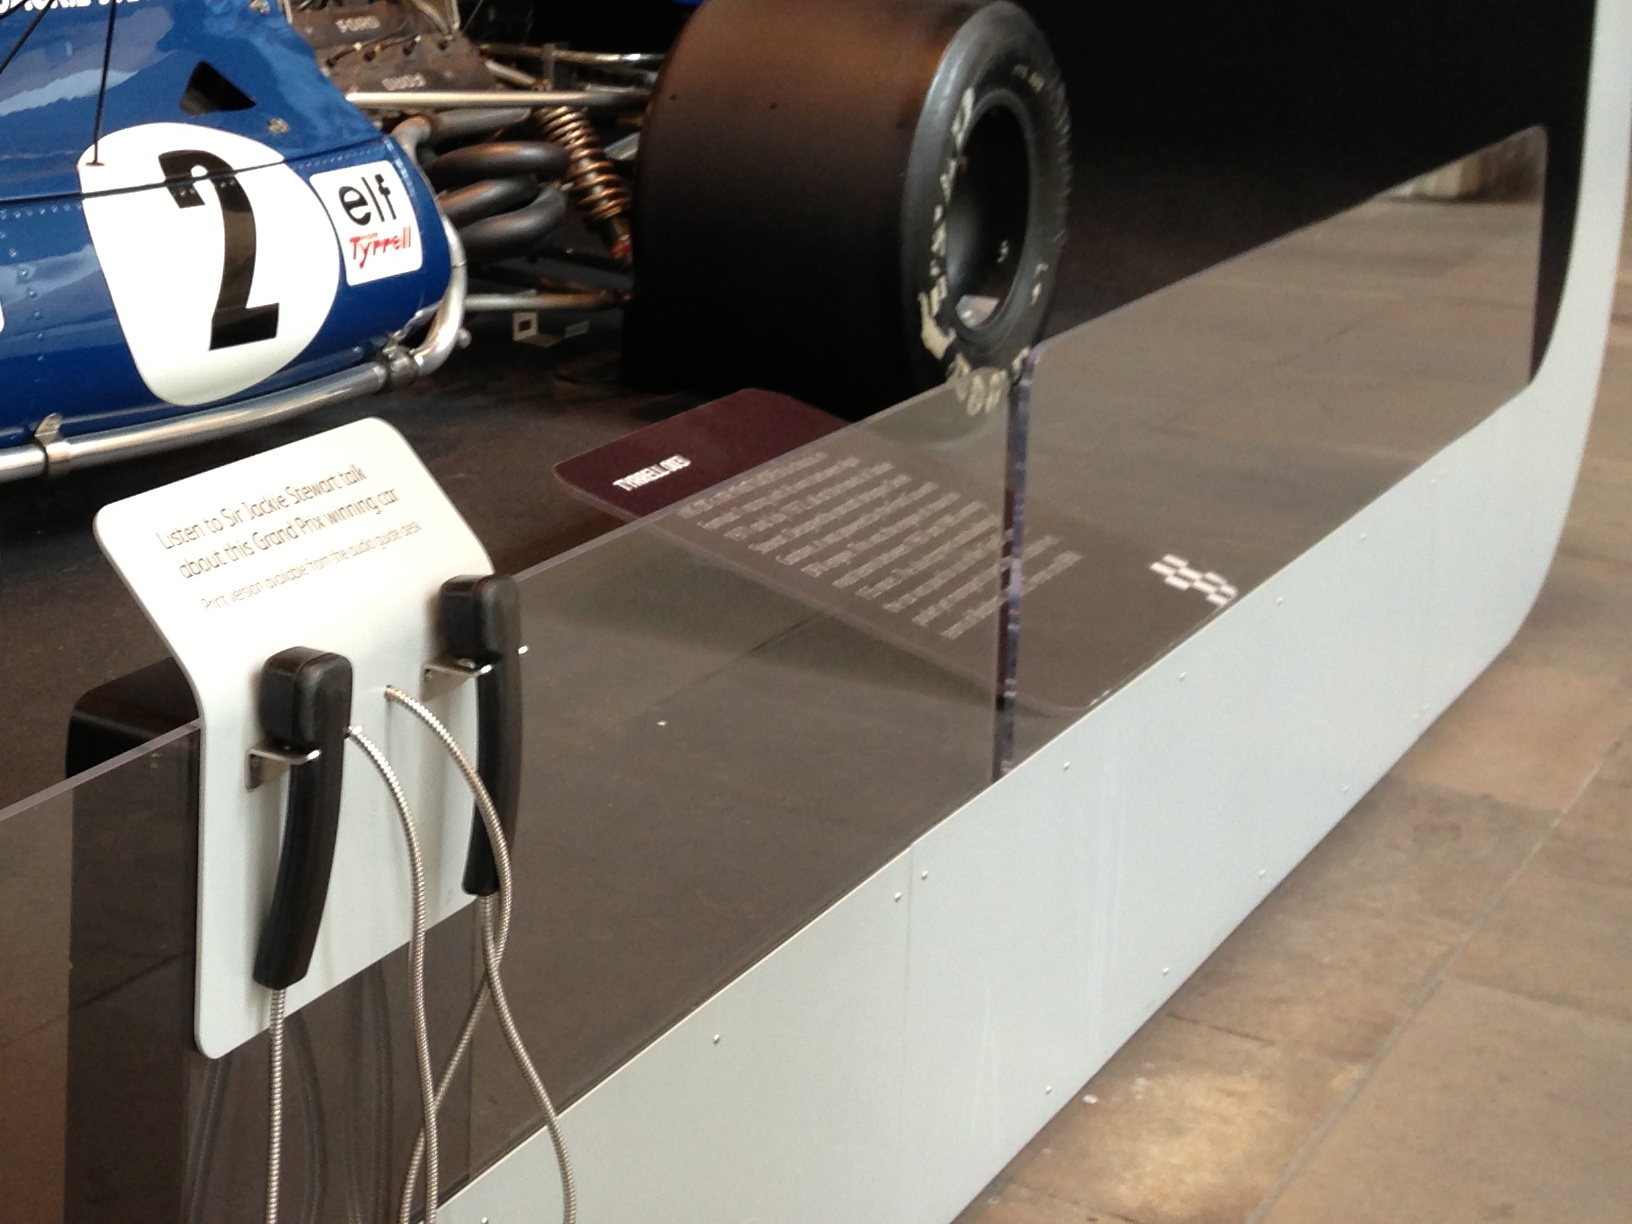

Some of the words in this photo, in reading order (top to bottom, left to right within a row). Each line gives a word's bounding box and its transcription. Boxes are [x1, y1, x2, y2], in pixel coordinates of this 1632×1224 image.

[338, 174, 397, 226] elf
[158, 149, 279, 351] 2
[349, 226, 411, 269] Tyrrell
[156, 524, 206, 550] Listen
[203, 517, 224, 533] to
[220, 508, 244, 527] Sir
[241, 494, 290, 520] Jackie
[285, 475, 344, 504] Stewart
[338, 463, 368, 486] talk
[179, 550, 228, 579] about
[223, 540, 255, 561] this
[252, 520, 300, 550] Grand
[294, 515, 327, 535] Prix
[324, 498, 382, 525] winning
[377, 488, 400, 506] car
